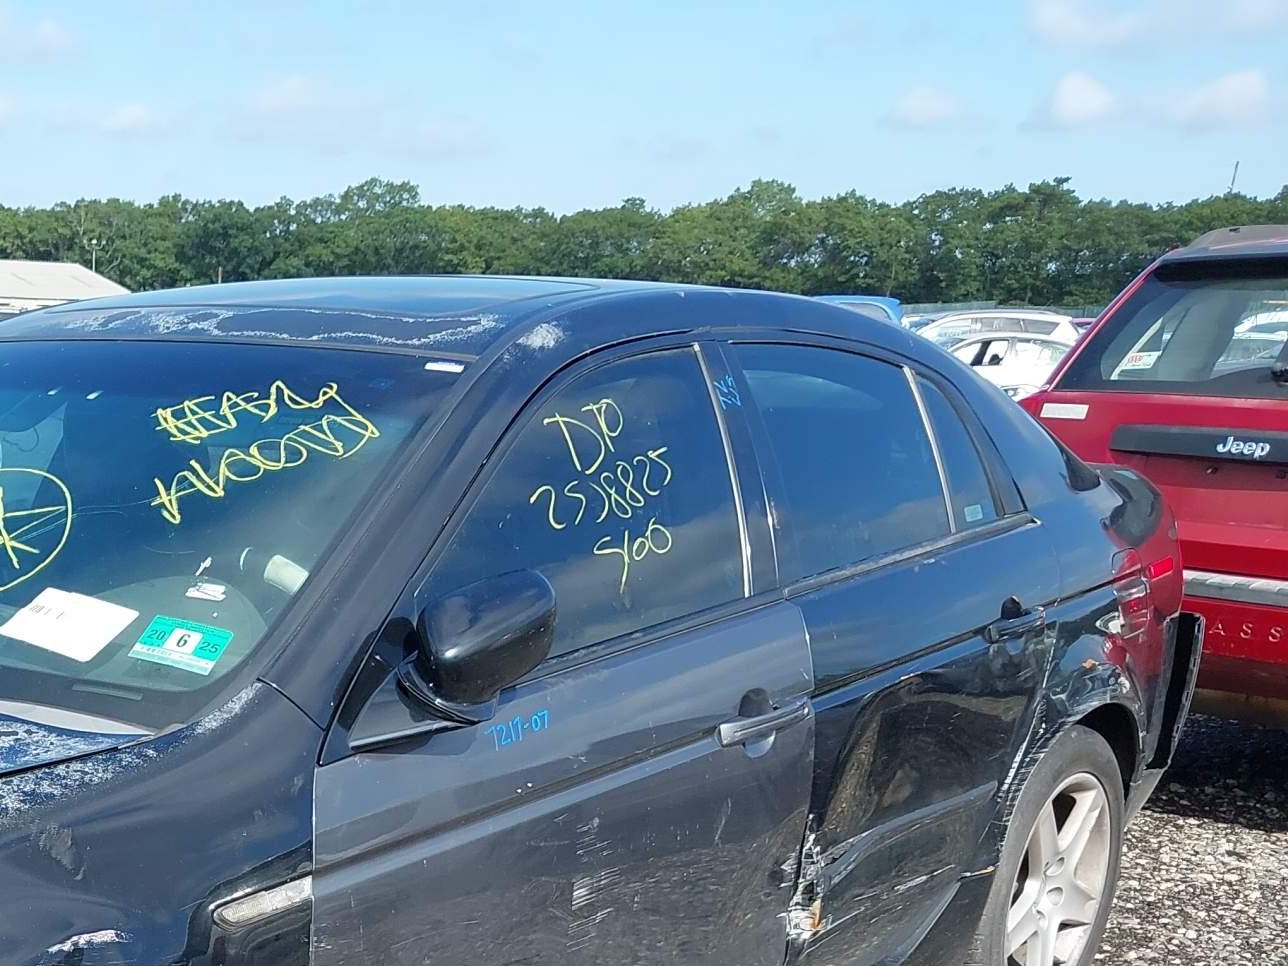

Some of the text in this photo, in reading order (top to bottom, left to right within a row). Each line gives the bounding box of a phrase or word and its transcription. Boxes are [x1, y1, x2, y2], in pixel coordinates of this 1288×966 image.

[1215, 435, 1271, 458] Jeep
[145, 628, 221, 654] 20 6 25
